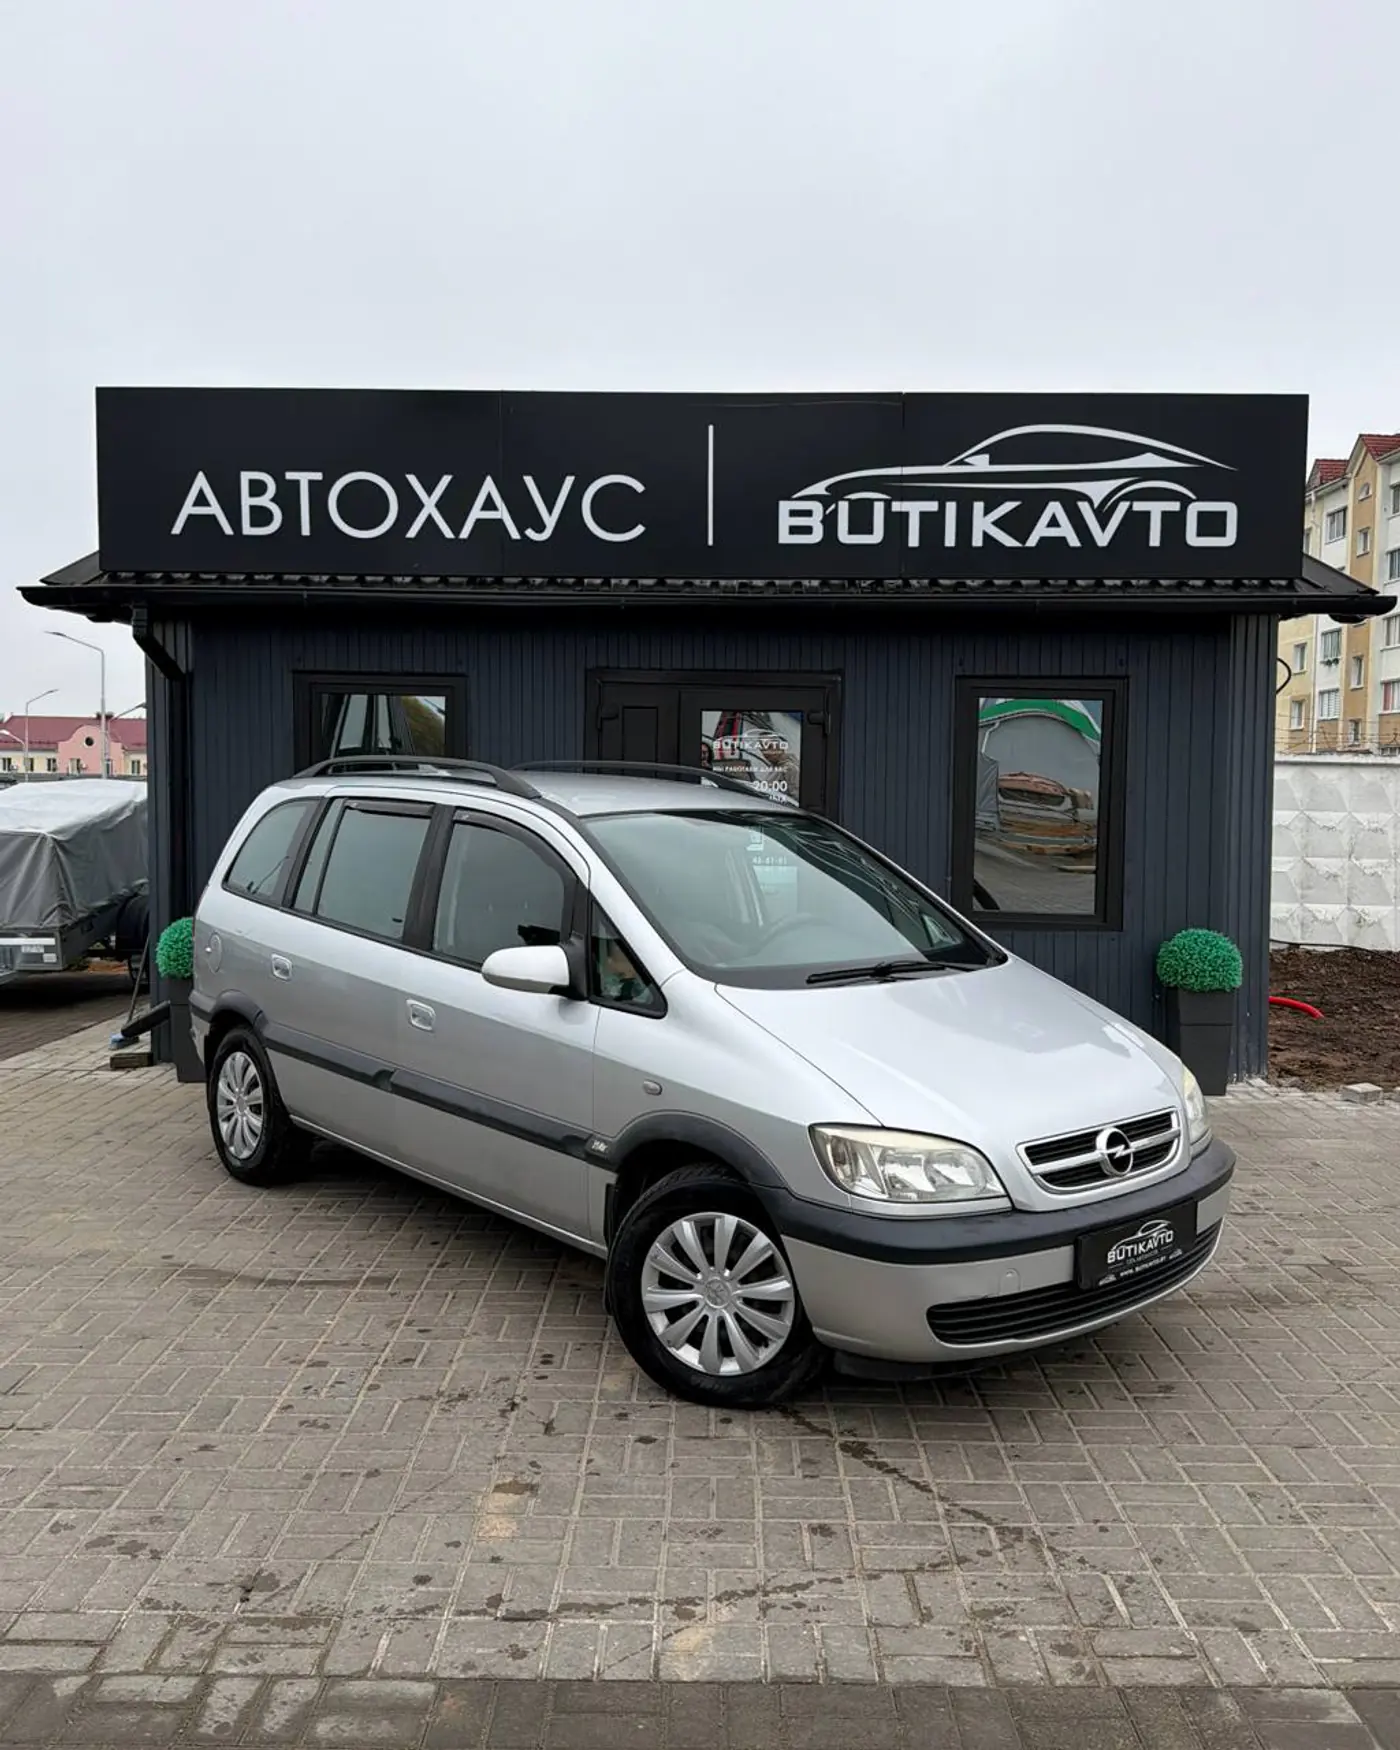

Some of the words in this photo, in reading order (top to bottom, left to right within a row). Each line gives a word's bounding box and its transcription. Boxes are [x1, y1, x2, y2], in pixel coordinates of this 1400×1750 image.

[171, 470, 647, 542] АВТОХАУС
[778, 500, 1238, 547] BUTIKAVTO
[713, 740, 788, 750] BUTIKAVTO
[1107, 1230, 1174, 1264] BUTIKAVTO
